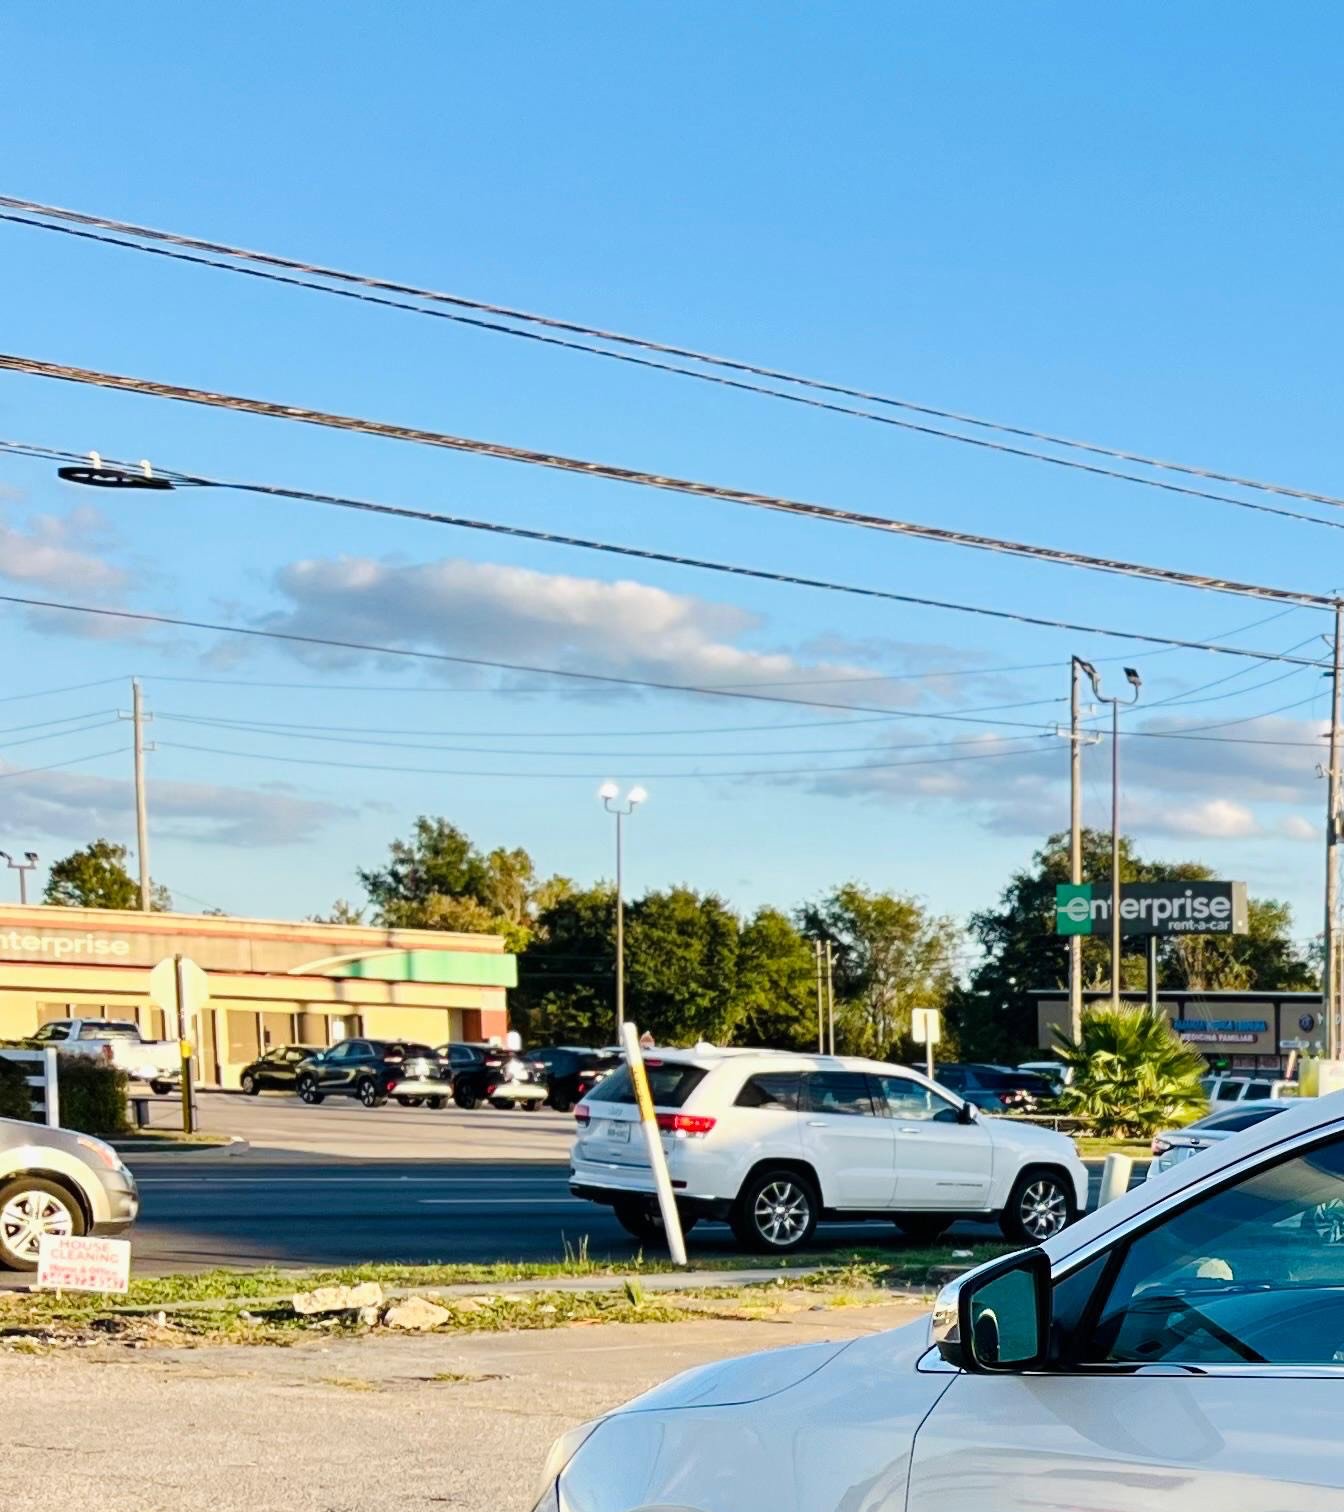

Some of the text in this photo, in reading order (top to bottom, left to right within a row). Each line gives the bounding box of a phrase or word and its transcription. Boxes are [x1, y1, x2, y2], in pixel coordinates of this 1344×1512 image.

[1060, 889, 1231, 927] enerprise
[1168, 920, 1230, 931] rent-a-car
[60, 1240, 109, 1252] HOUSE
[50, 1249, 119, 1264] CLEANING
